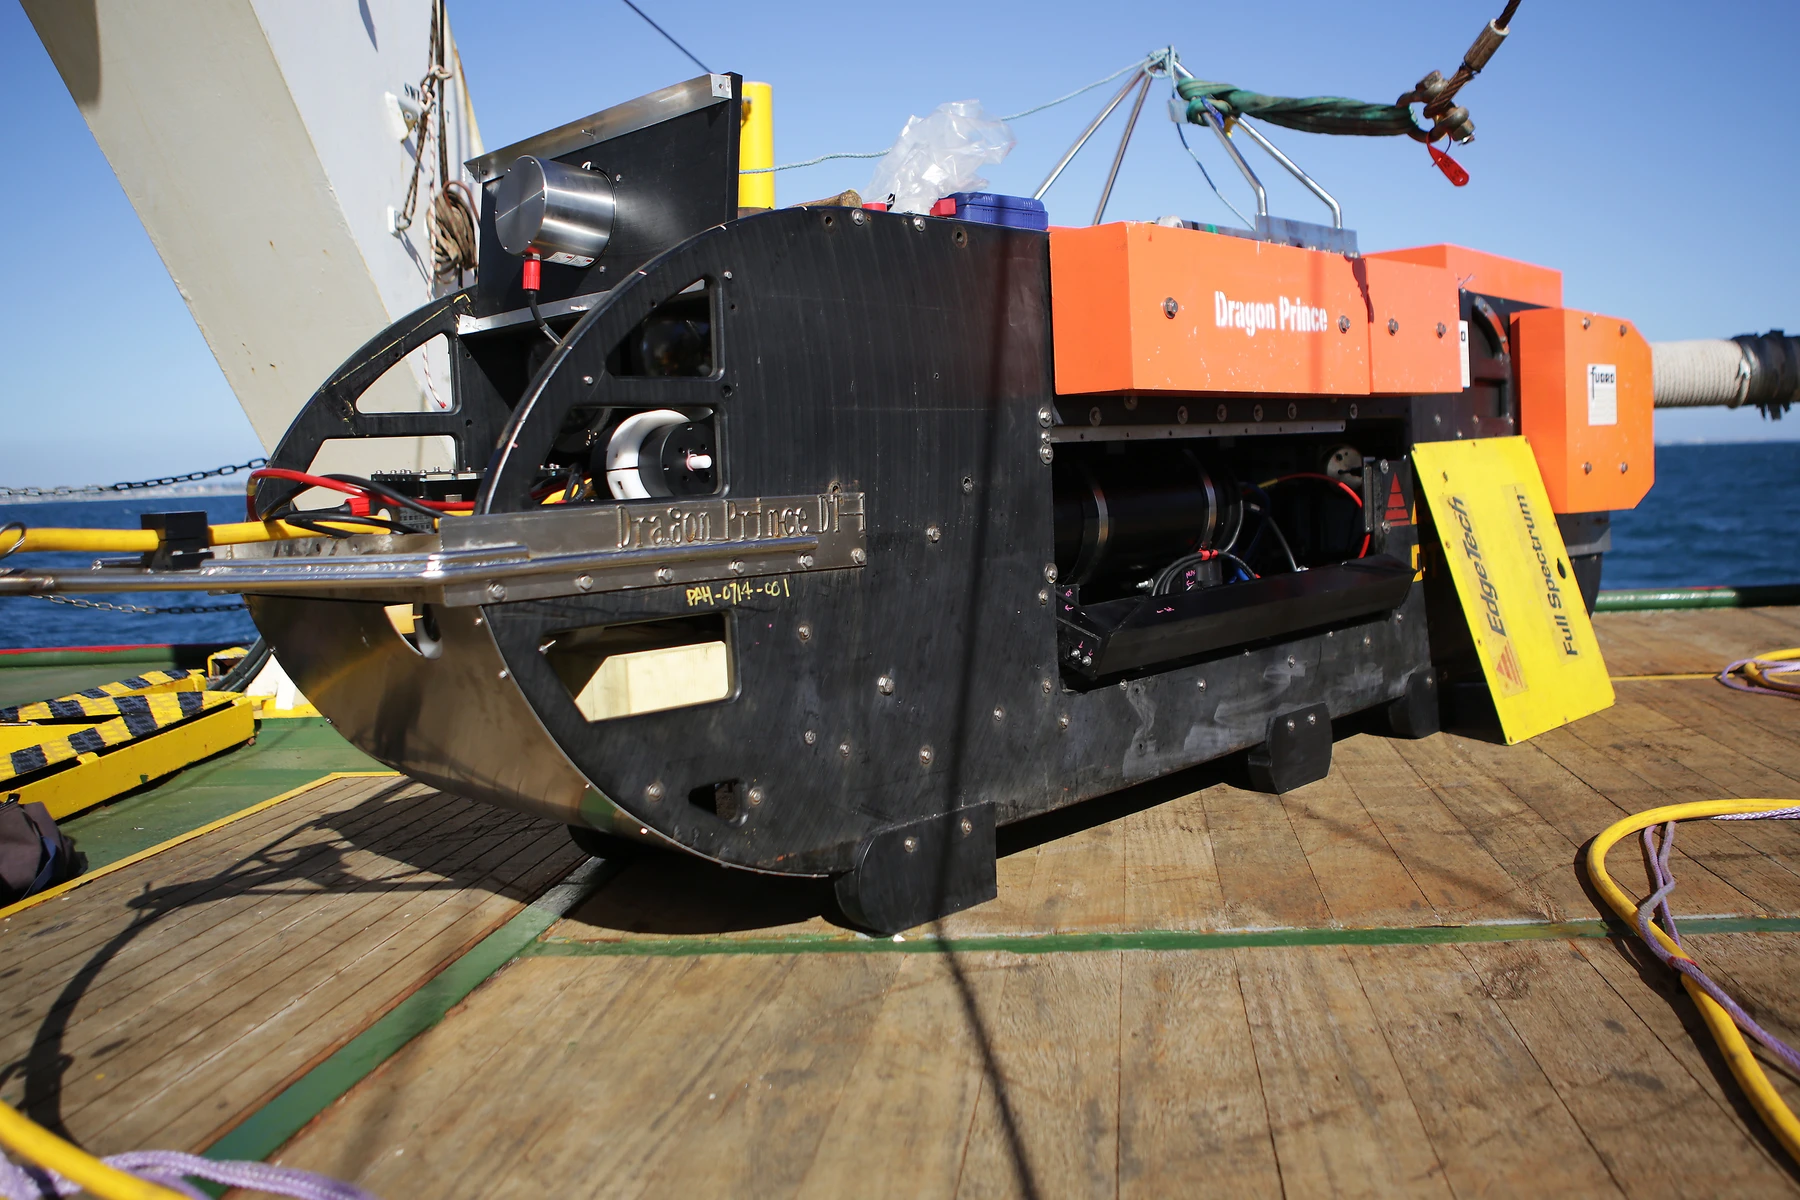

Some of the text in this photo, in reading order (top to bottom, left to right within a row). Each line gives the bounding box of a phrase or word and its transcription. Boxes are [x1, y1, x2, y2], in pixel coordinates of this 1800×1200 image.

[1214, 290, 1328, 337] Dragon Prince
[616, 504, 711, 549] Dragon
[723, 497, 809, 540] Prince
[1447, 496, 1507, 637] EdgeTech
[1516, 493, 1579, 657] Full Spectrum
